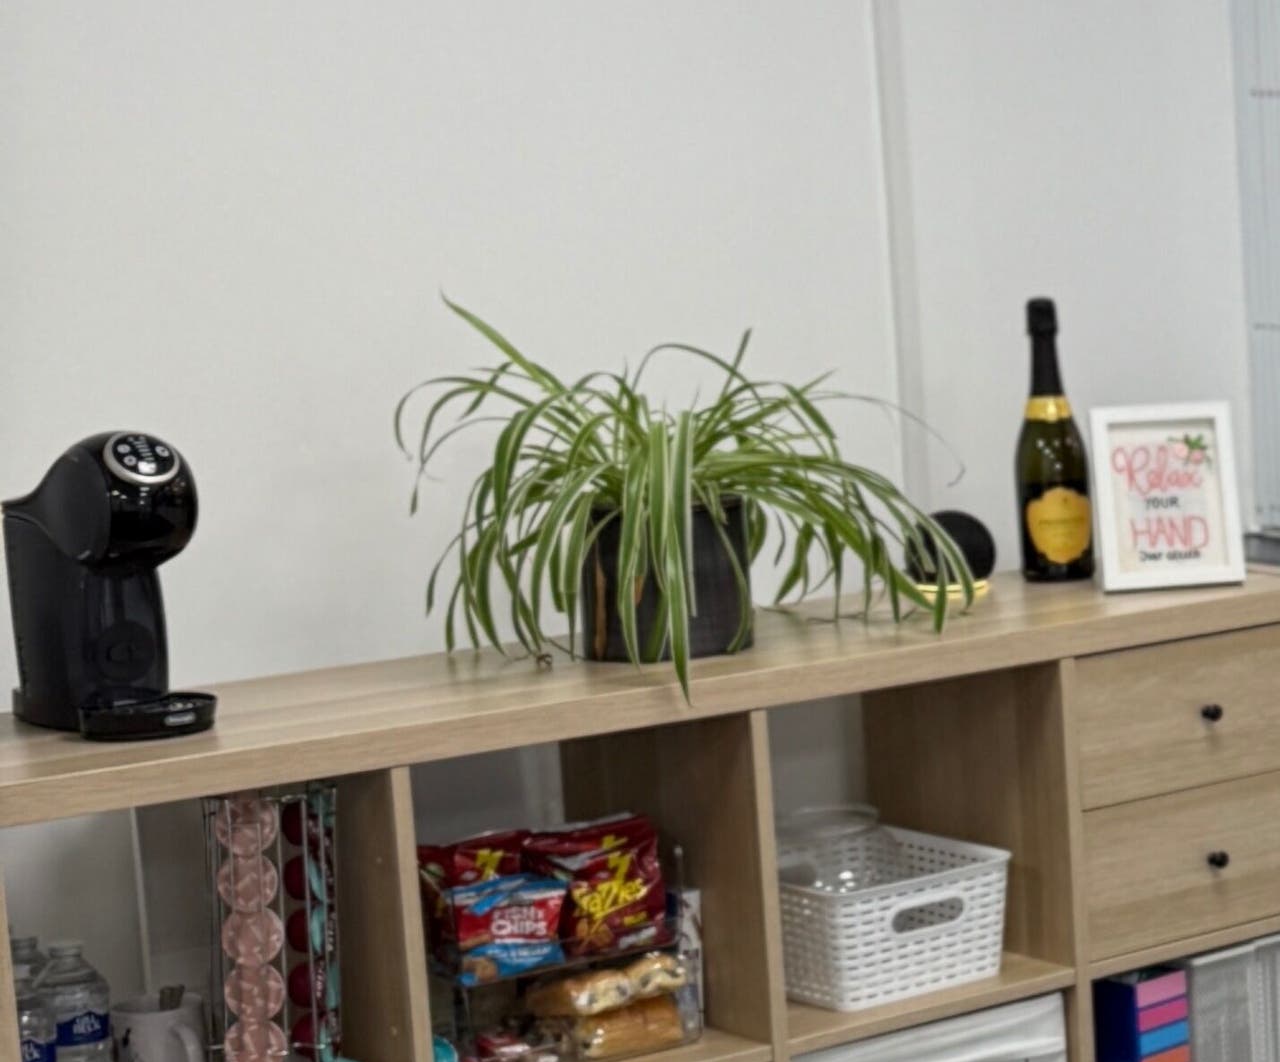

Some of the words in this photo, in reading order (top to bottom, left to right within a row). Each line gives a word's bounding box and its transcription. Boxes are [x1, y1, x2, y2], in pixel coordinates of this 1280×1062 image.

[1113, 446, 1202, 497] Relax
[1145, 497, 1181, 509] YOUR
[1129, 516, 1210, 550] HAND
